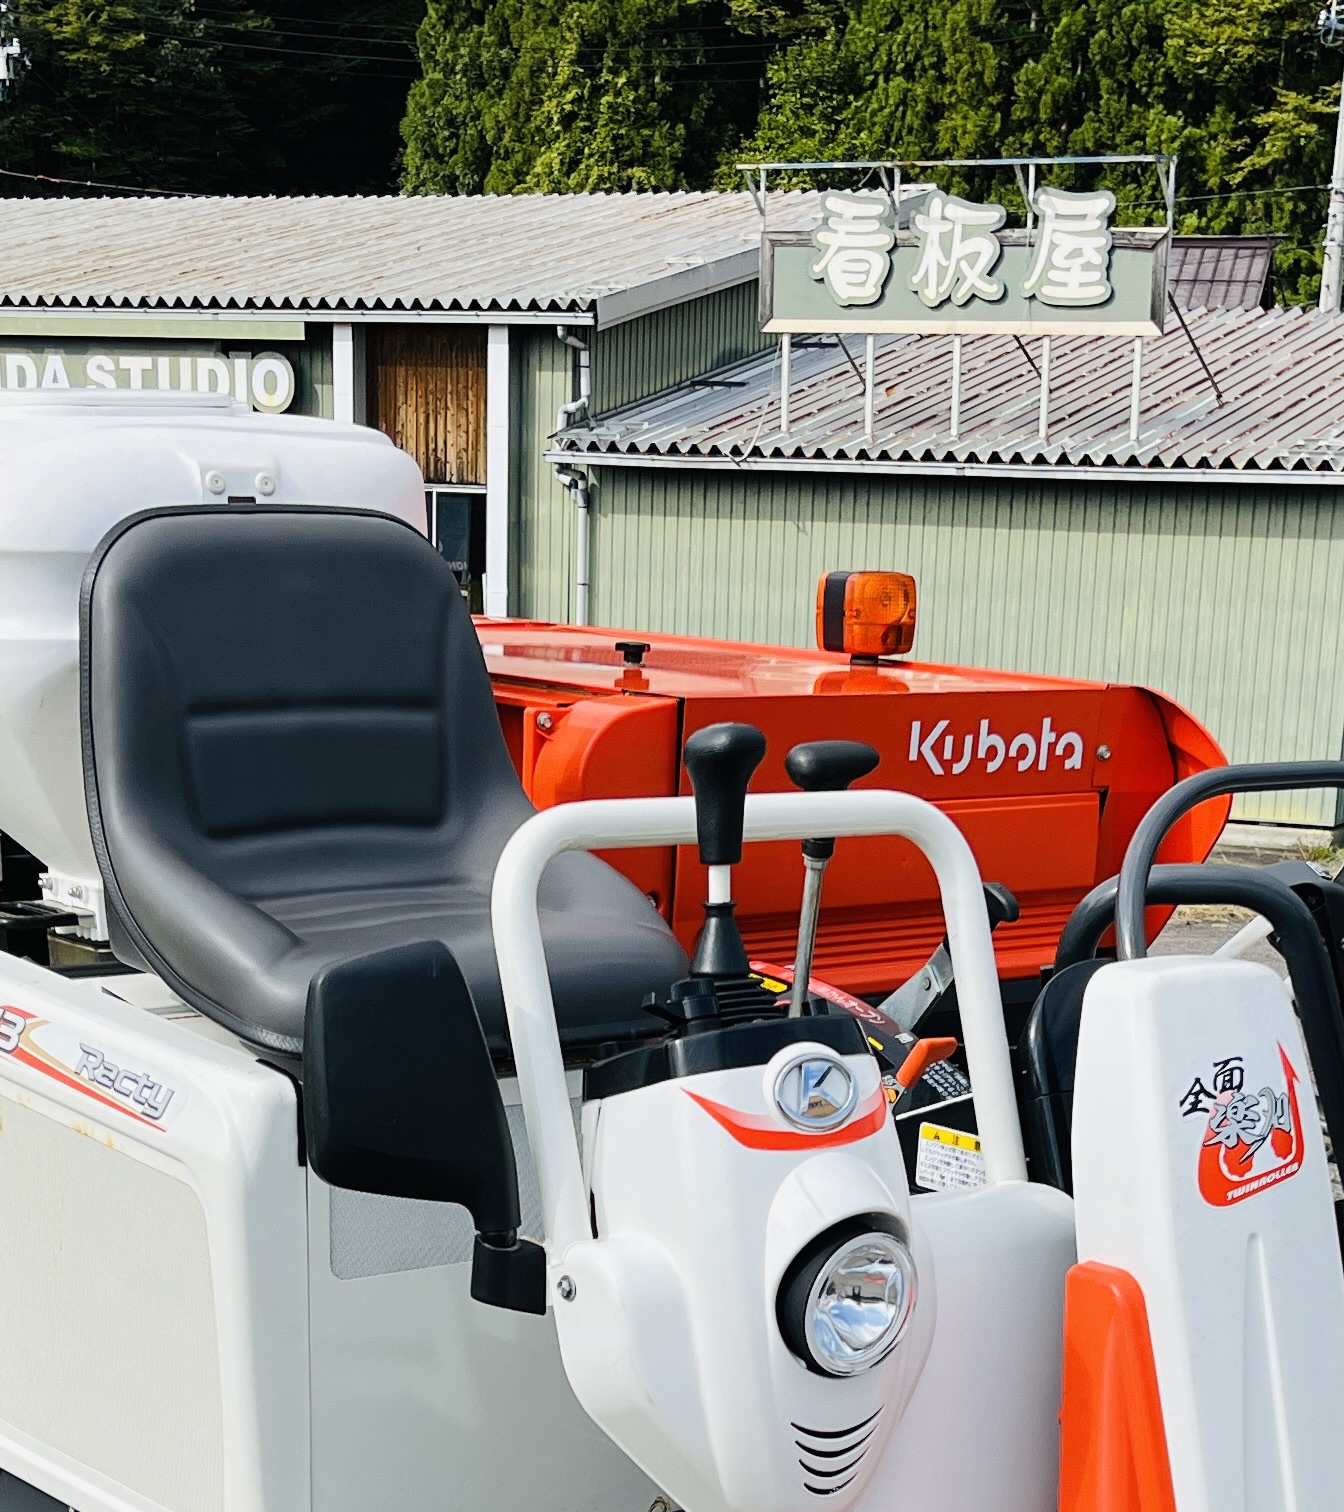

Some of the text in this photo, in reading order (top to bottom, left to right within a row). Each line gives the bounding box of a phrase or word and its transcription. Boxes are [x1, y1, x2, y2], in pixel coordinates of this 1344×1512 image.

[811, 191, 1113, 302] 看板屋
[86, 353, 291, 407] STUDIO
[908, 716, 1084, 776] Kubota
[74, 1042, 175, 1121] Racty
[1179, 1056, 1245, 1117] 全面
